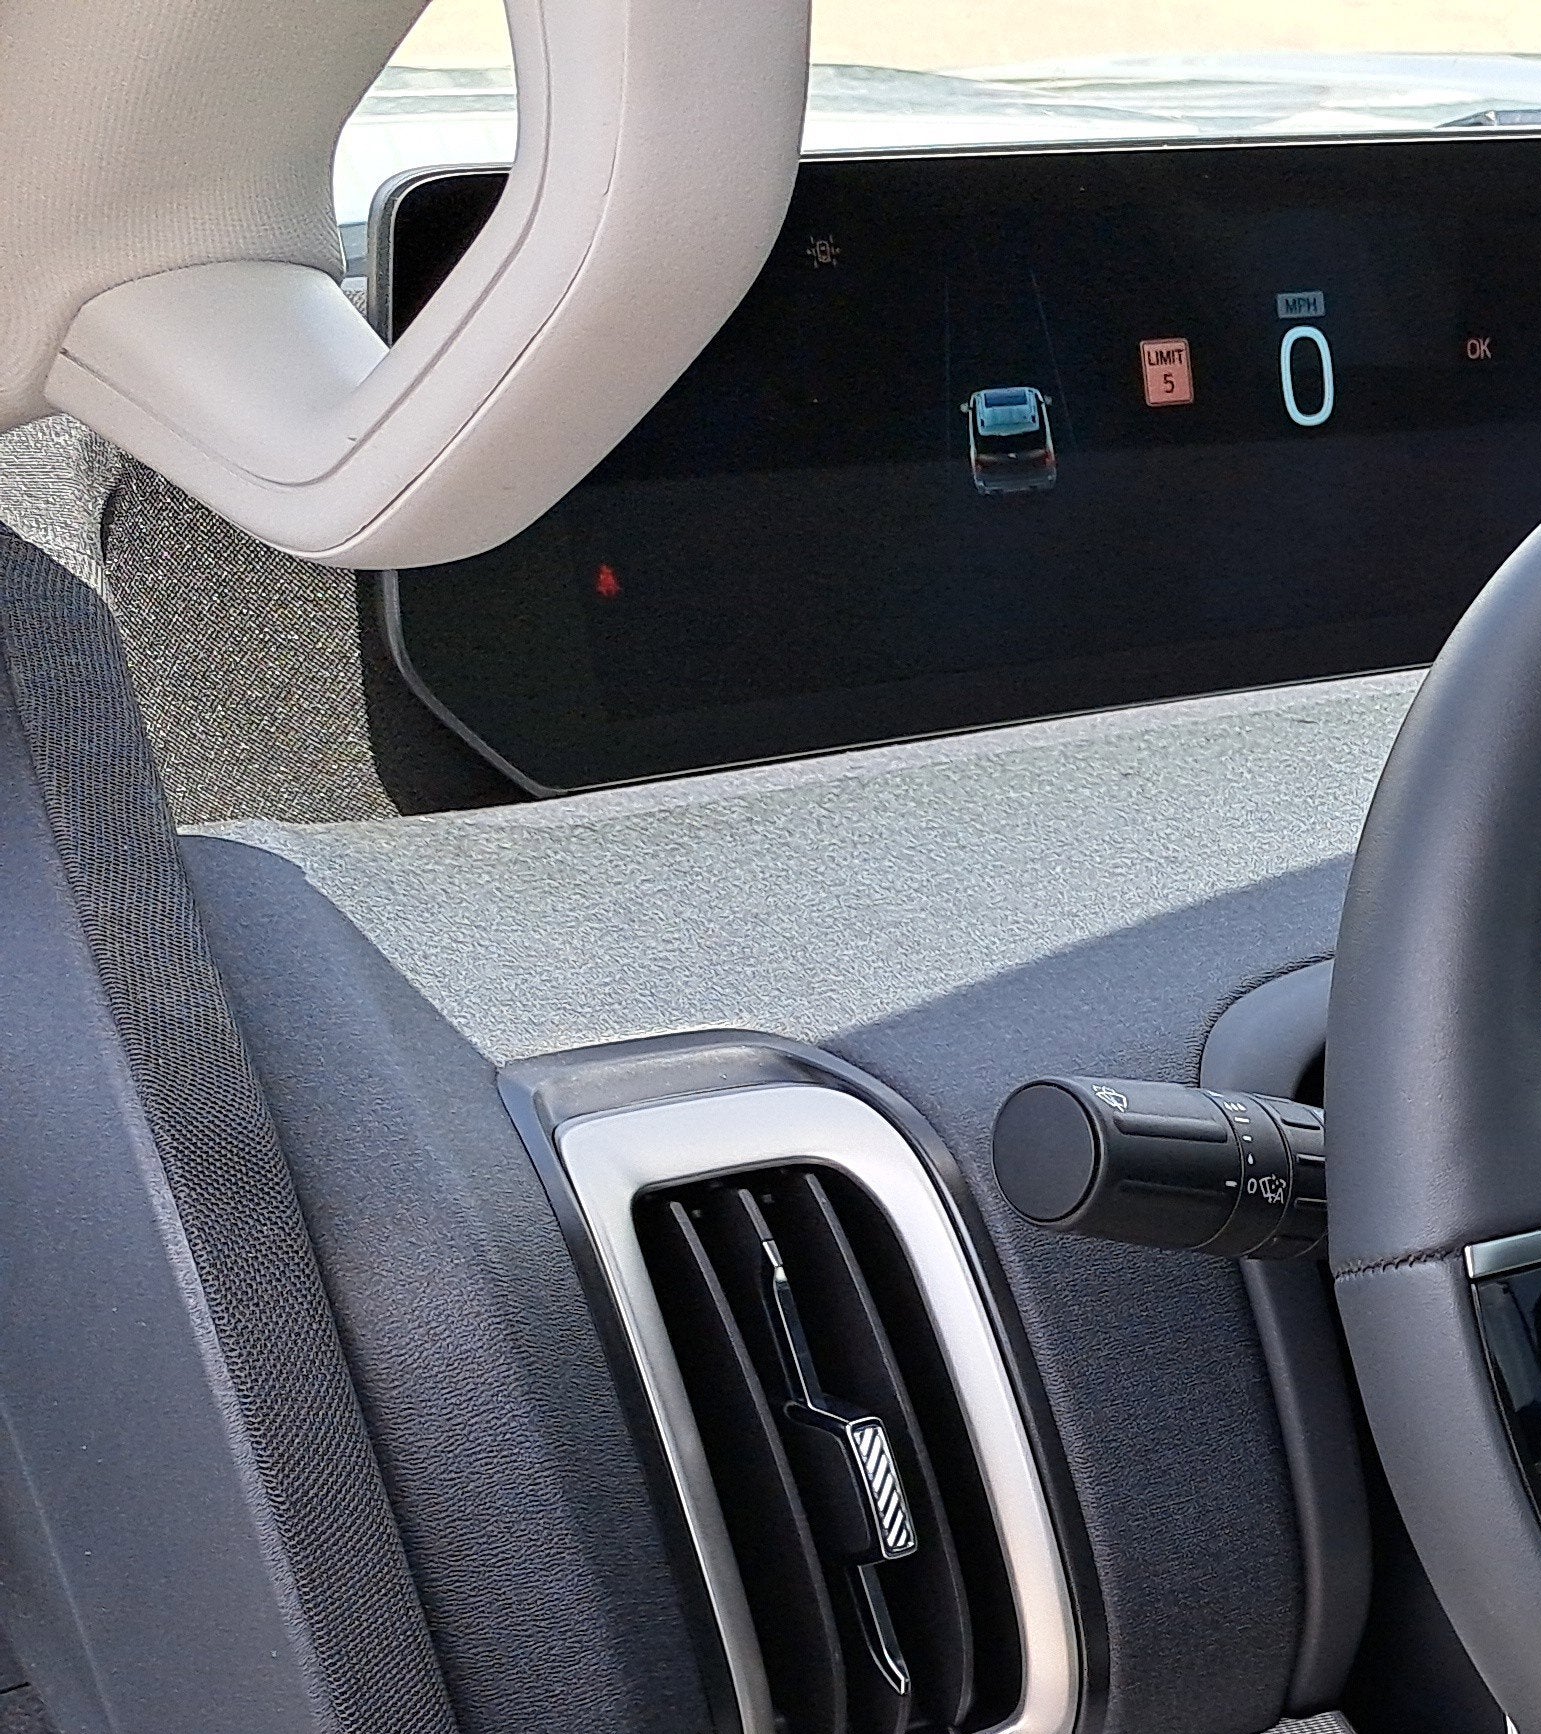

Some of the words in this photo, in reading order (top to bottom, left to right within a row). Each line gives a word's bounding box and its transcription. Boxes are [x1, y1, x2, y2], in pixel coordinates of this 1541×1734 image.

[1284, 297, 1319, 316] MPH
[1147, 349, 1185, 366] LIMIT
[1466, 337, 1492, 361] OK
[1162, 373, 1175, 394] 5
[1280, 324, 1334, 427] 0
